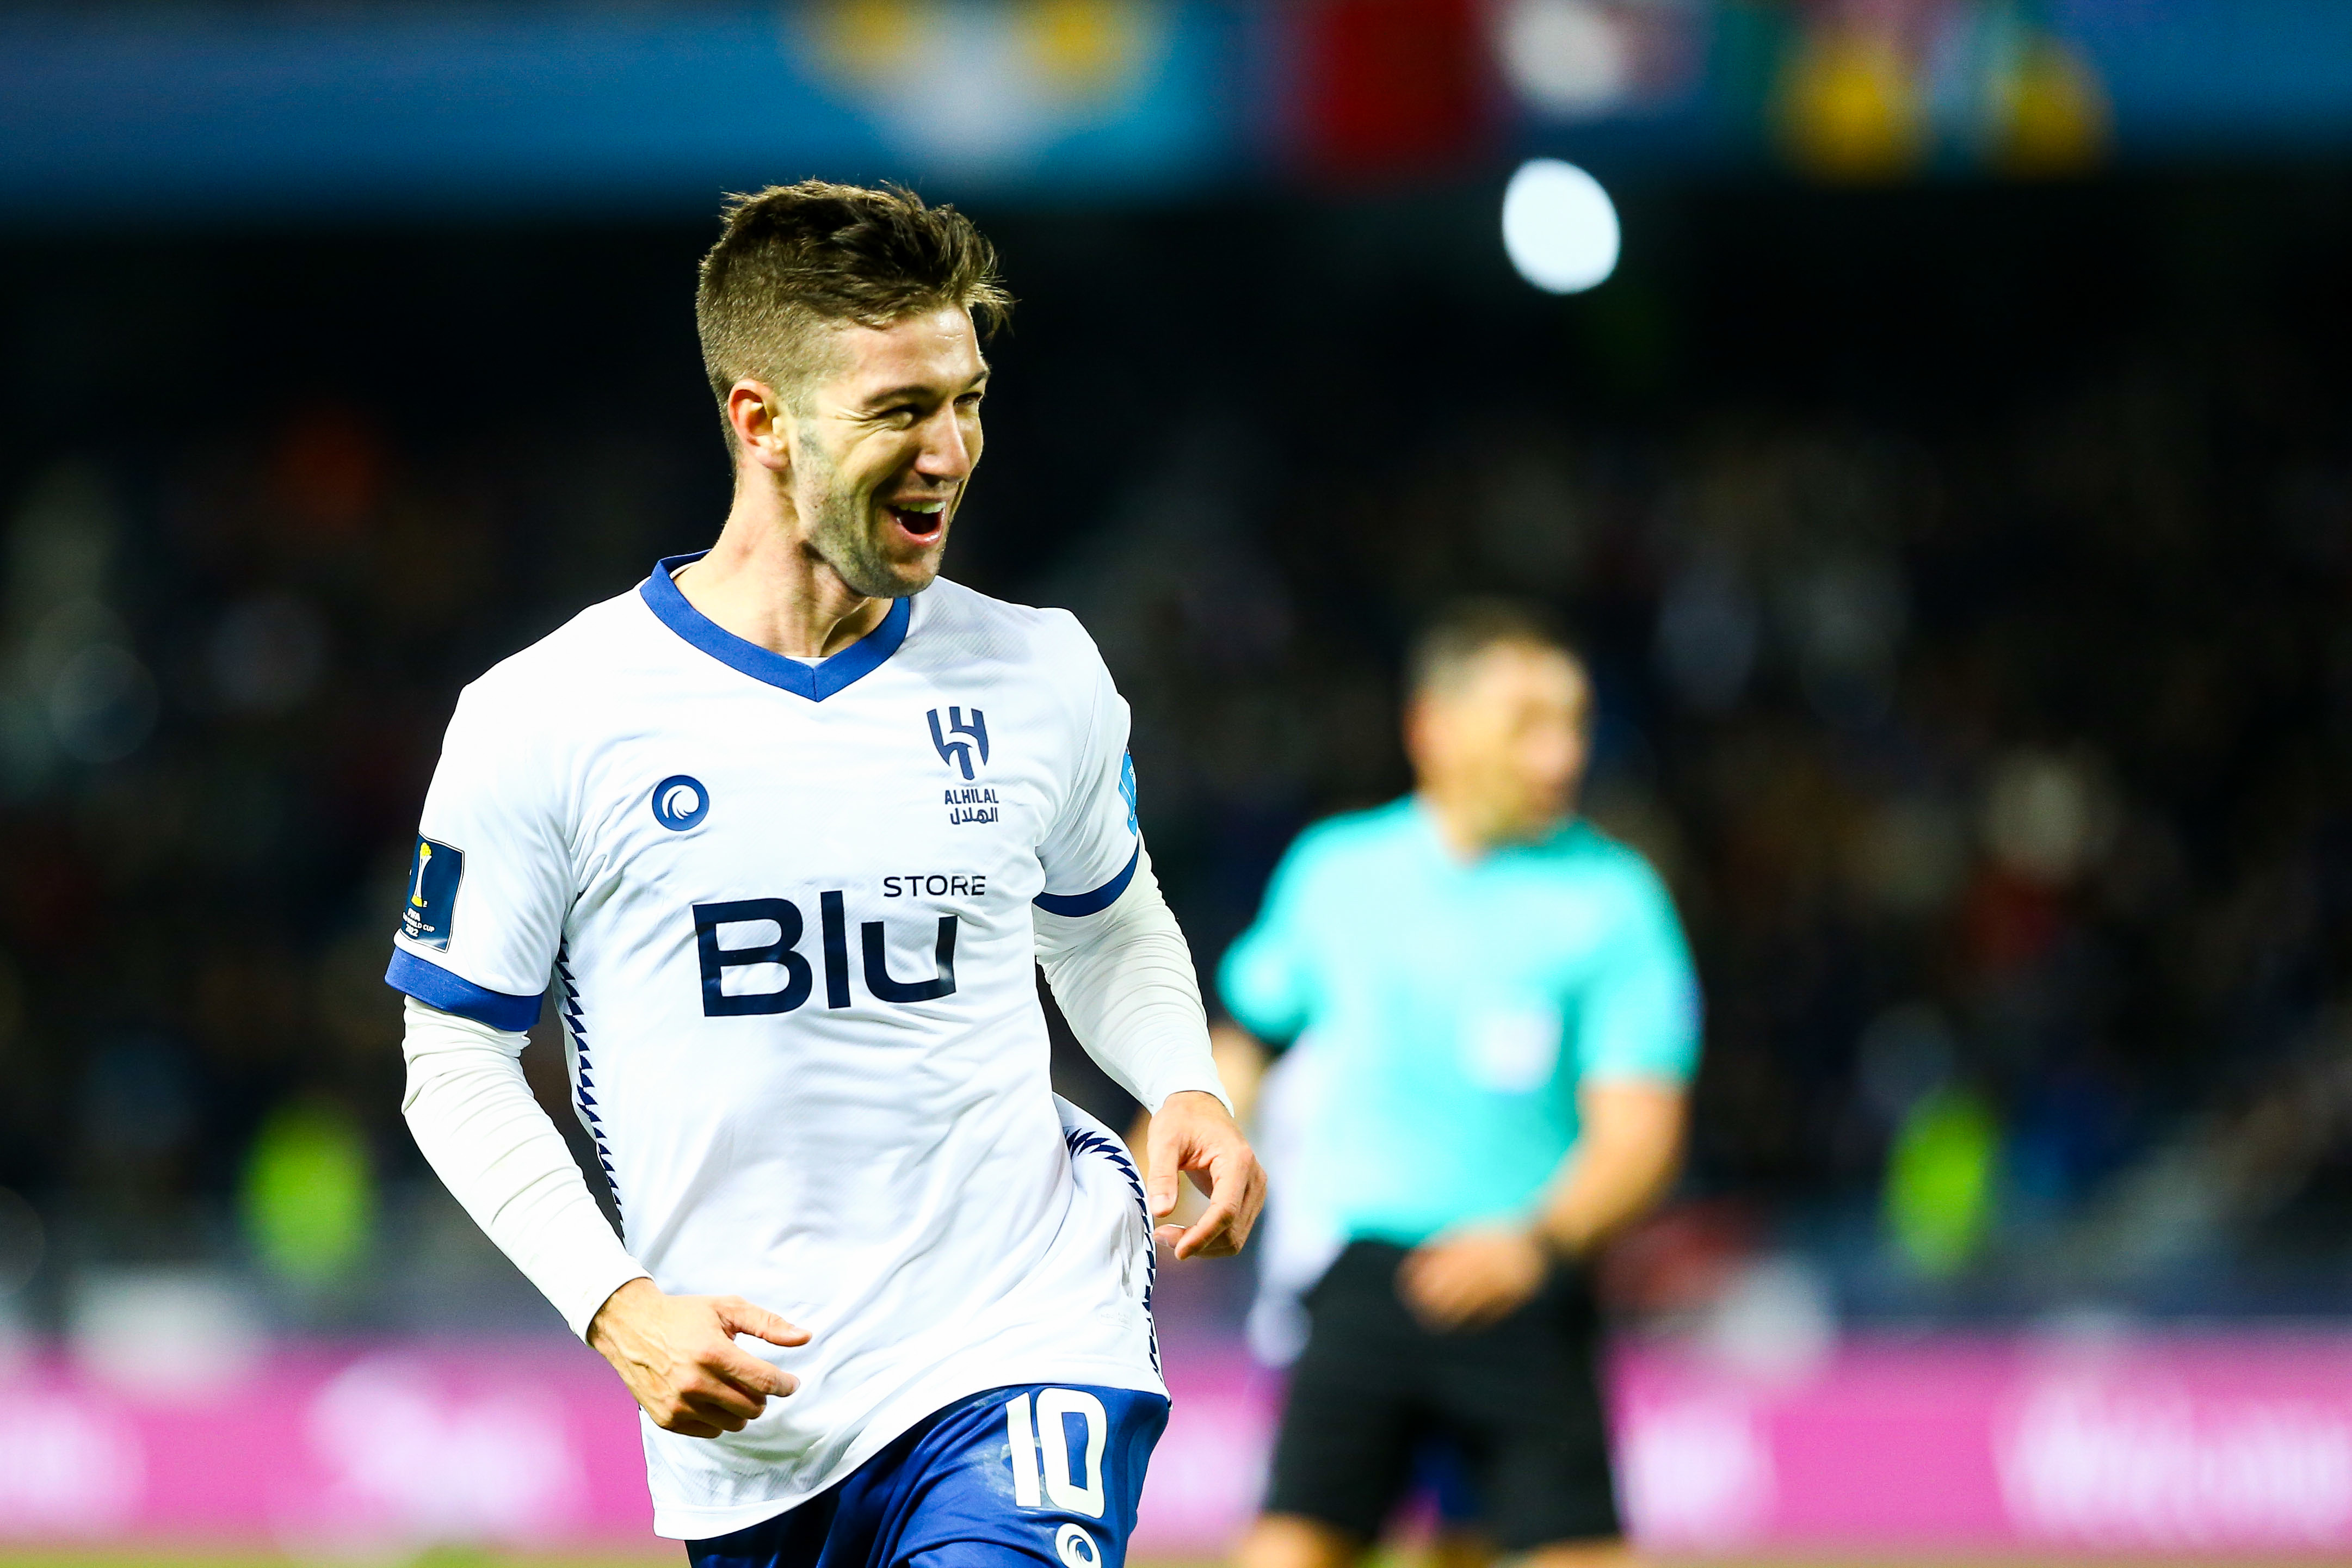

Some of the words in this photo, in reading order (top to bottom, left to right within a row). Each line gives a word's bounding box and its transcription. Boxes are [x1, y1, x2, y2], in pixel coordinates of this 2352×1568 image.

[950, 807, 998, 824] الهلال
[884, 875, 986, 897] STORE
[408, 908, 421, 922] FIFA
[423, 924, 435, 933] CUP
[692, 890, 958, 1017] Blu
[1005, 1387, 1107, 1519] 10
